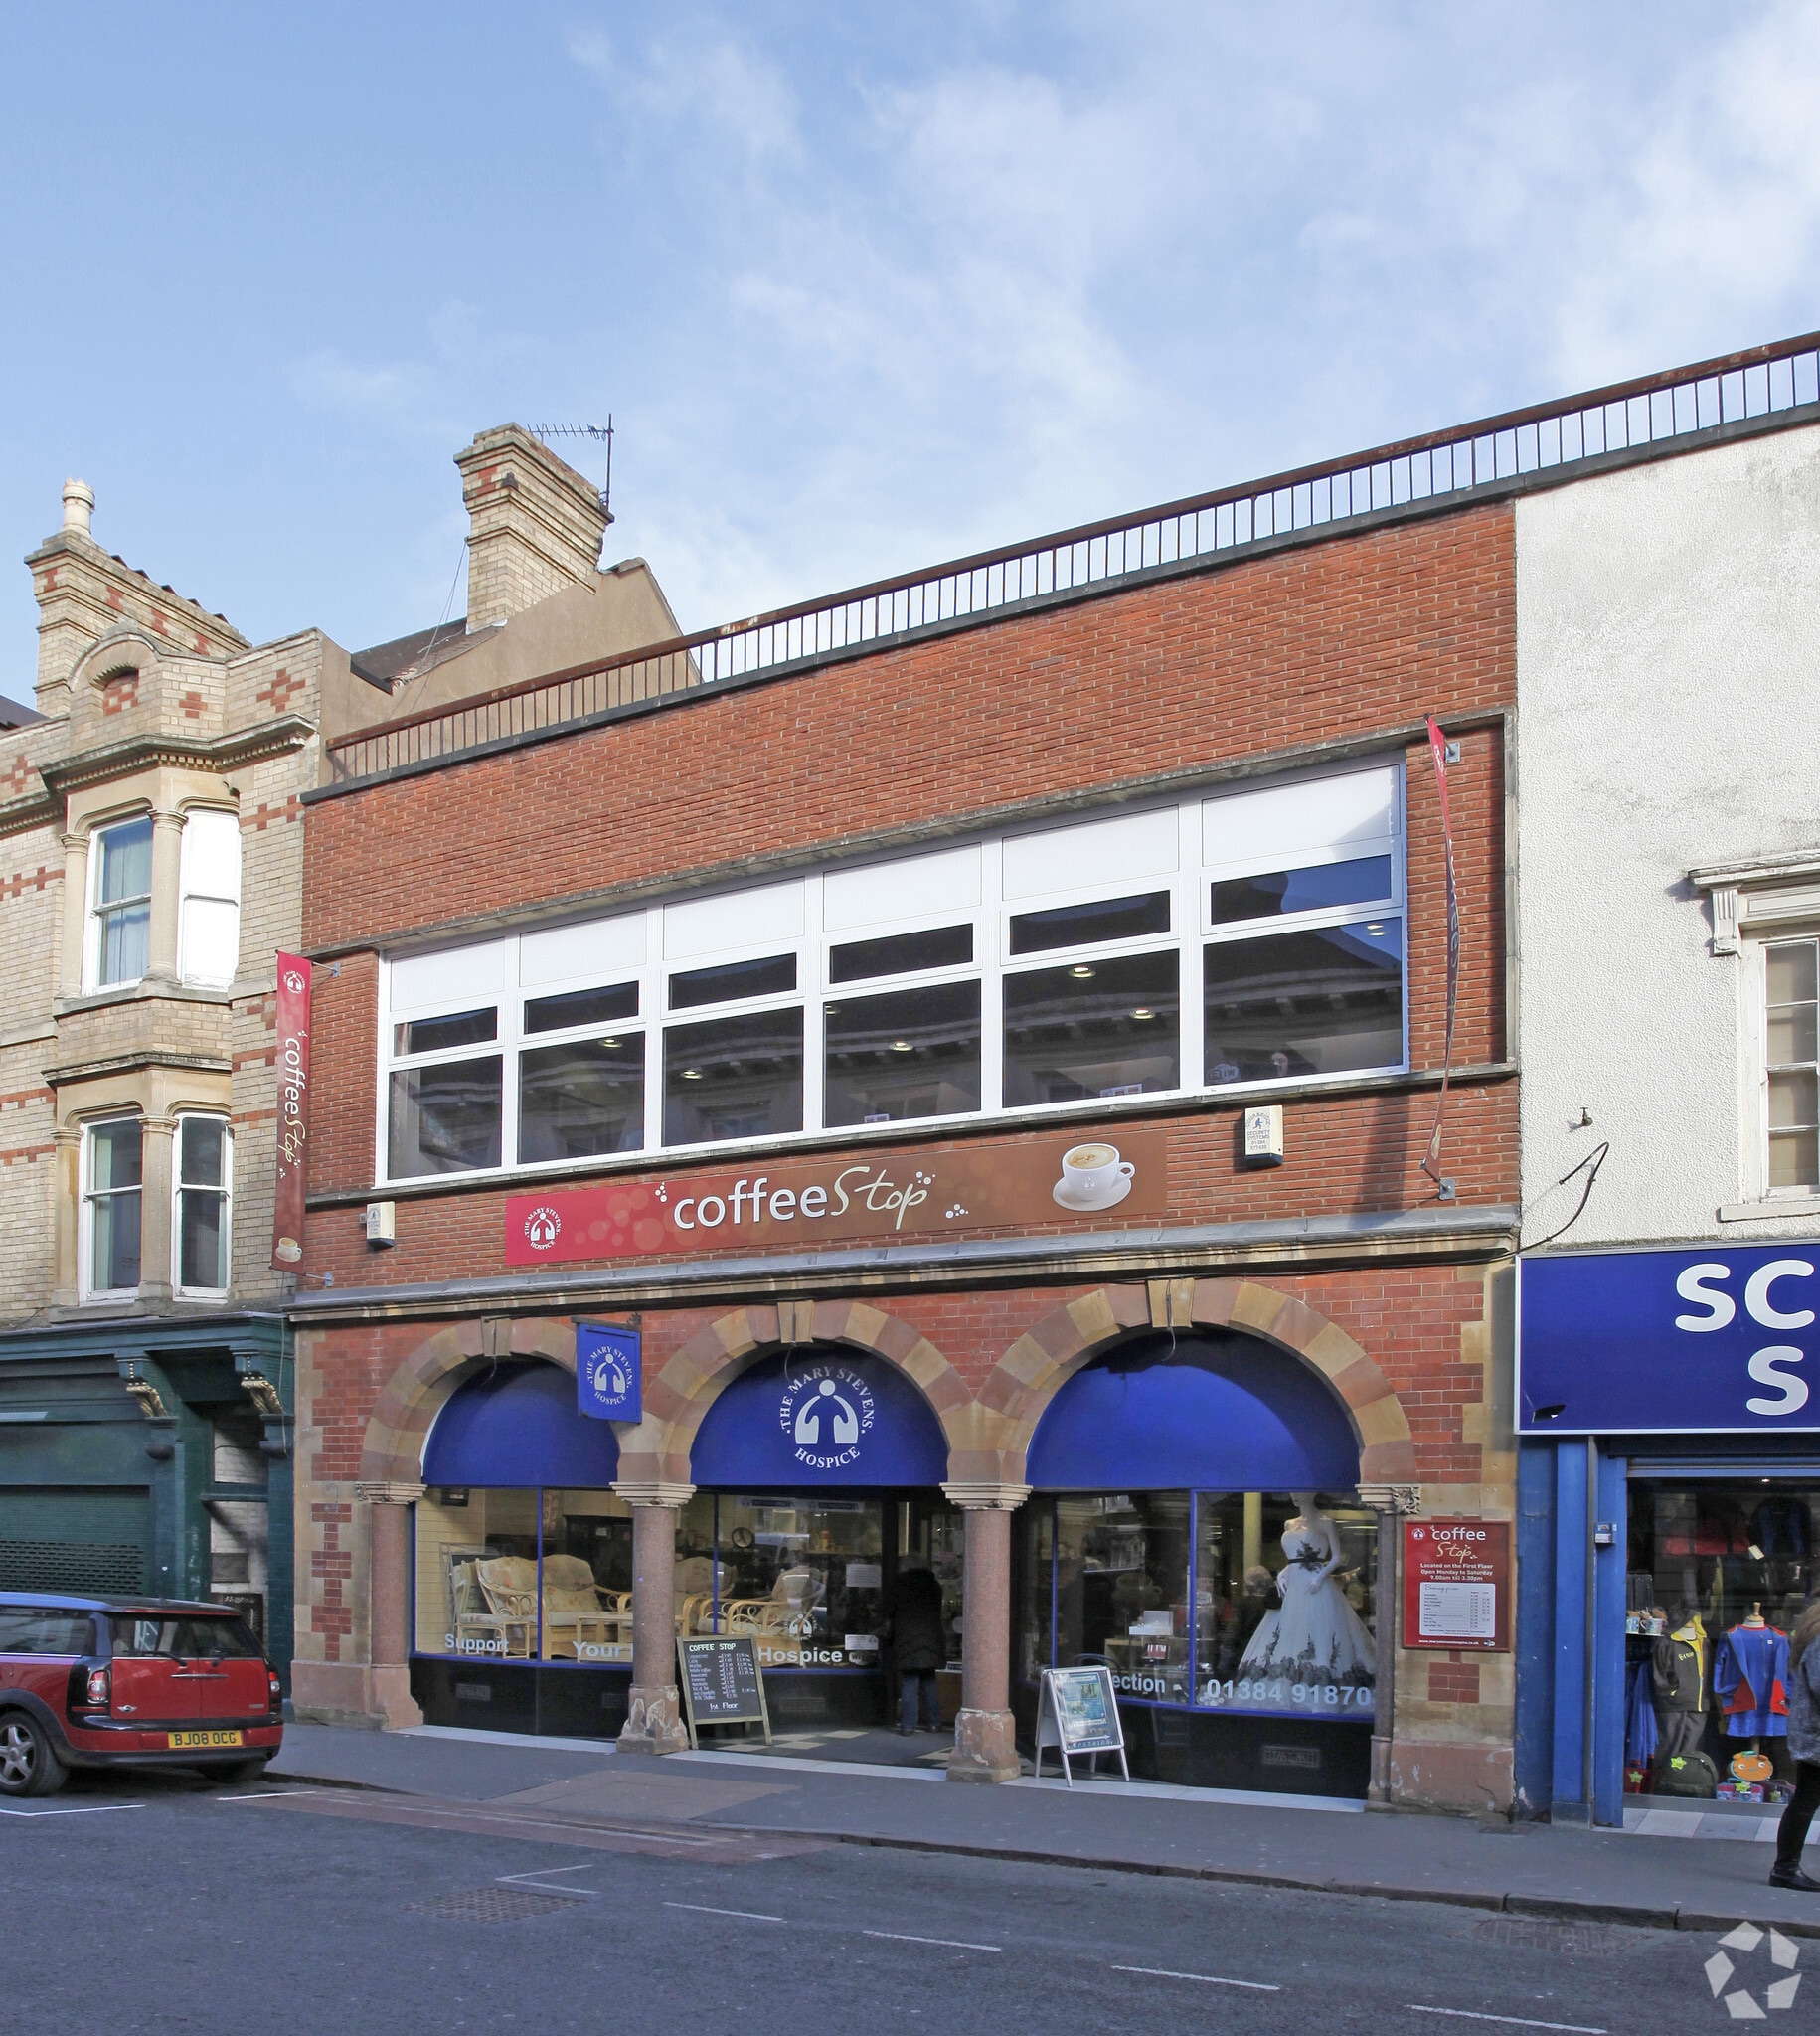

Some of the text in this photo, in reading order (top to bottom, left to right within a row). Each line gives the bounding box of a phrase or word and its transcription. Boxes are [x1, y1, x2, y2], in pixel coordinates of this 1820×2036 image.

[527, 1207, 545, 1221] MARY
[545, 1207, 562, 1234] STEVENS
[530, 1240, 556, 1251] HOSPICE
[590, 1345, 612, 1361] MARY
[613, 1348, 633, 1386] STEVENS
[1745, 1345, 1809, 1416] S
[594, 1391, 627, 1405] HOSPICE
[779, 1366, 875, 1430] THE MARY STEVENS
[794, 1446, 861, 1469] HOSPICE
[1431, 1527, 1486, 1541] coffee
[1436, 1541, 1472, 1564] Stop
[444, 1633, 509, 1654] Support
[572, 1640, 622, 1658] Your
[688, 1643, 715, 1652] COFFEE
[757, 1646, 843, 1667] Hospice
[1206, 1678, 1283, 1702] 01384
[174, 1732, 237, 1746] BJ08 OCG
